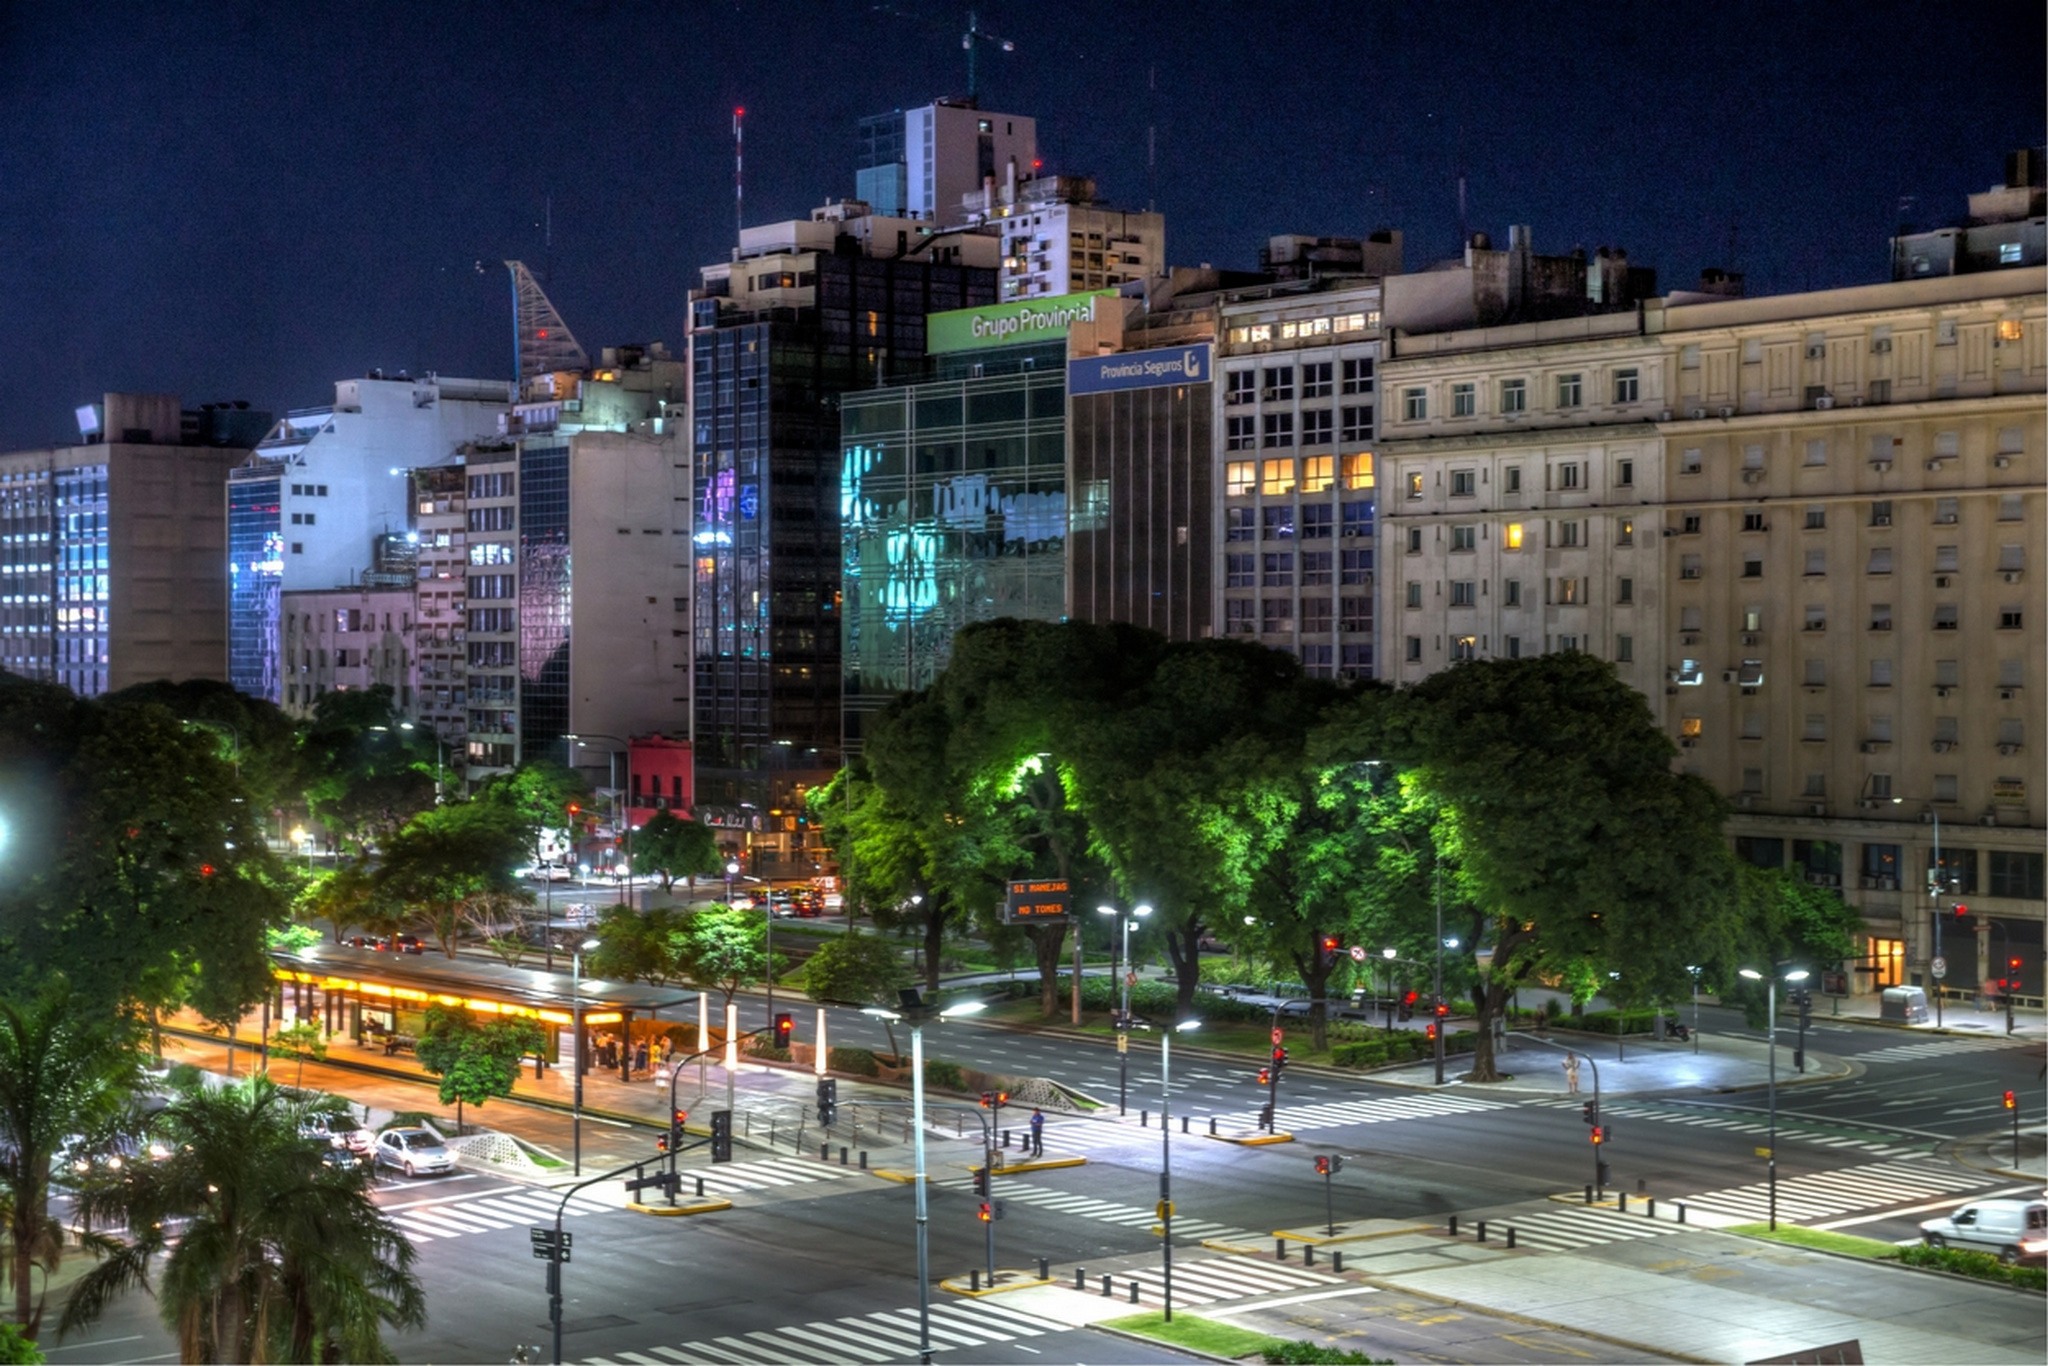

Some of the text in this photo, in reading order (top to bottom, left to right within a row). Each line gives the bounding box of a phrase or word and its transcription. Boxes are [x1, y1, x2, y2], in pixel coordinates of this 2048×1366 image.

[972, 315, 1018, 340] Grupo
[1101, 360, 1182, 379] Provincia Seguros
[1013, 881, 1068, 894] SI MANEJAS
[1018, 903, 1063, 915] NO TOMES
